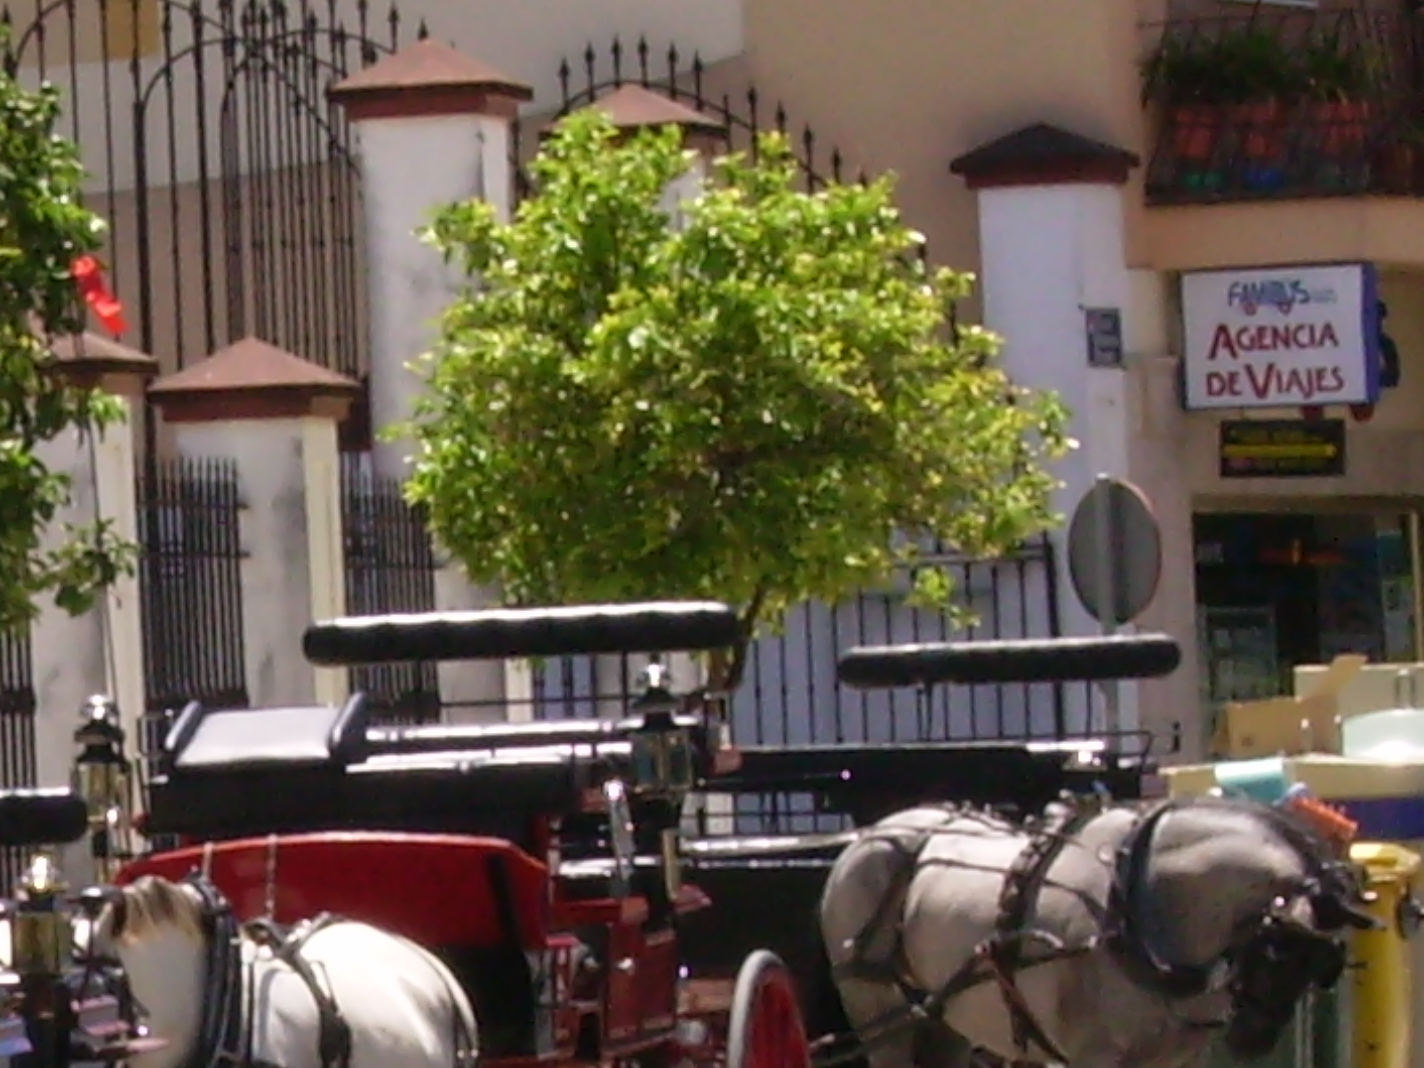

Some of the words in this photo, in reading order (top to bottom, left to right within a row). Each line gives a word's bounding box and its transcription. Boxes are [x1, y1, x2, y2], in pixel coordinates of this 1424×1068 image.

[1207, 323, 1339, 360] AGENCIA
[1205, 371, 1243, 397] DE
[1244, 363, 1345, 399] VIAJES
